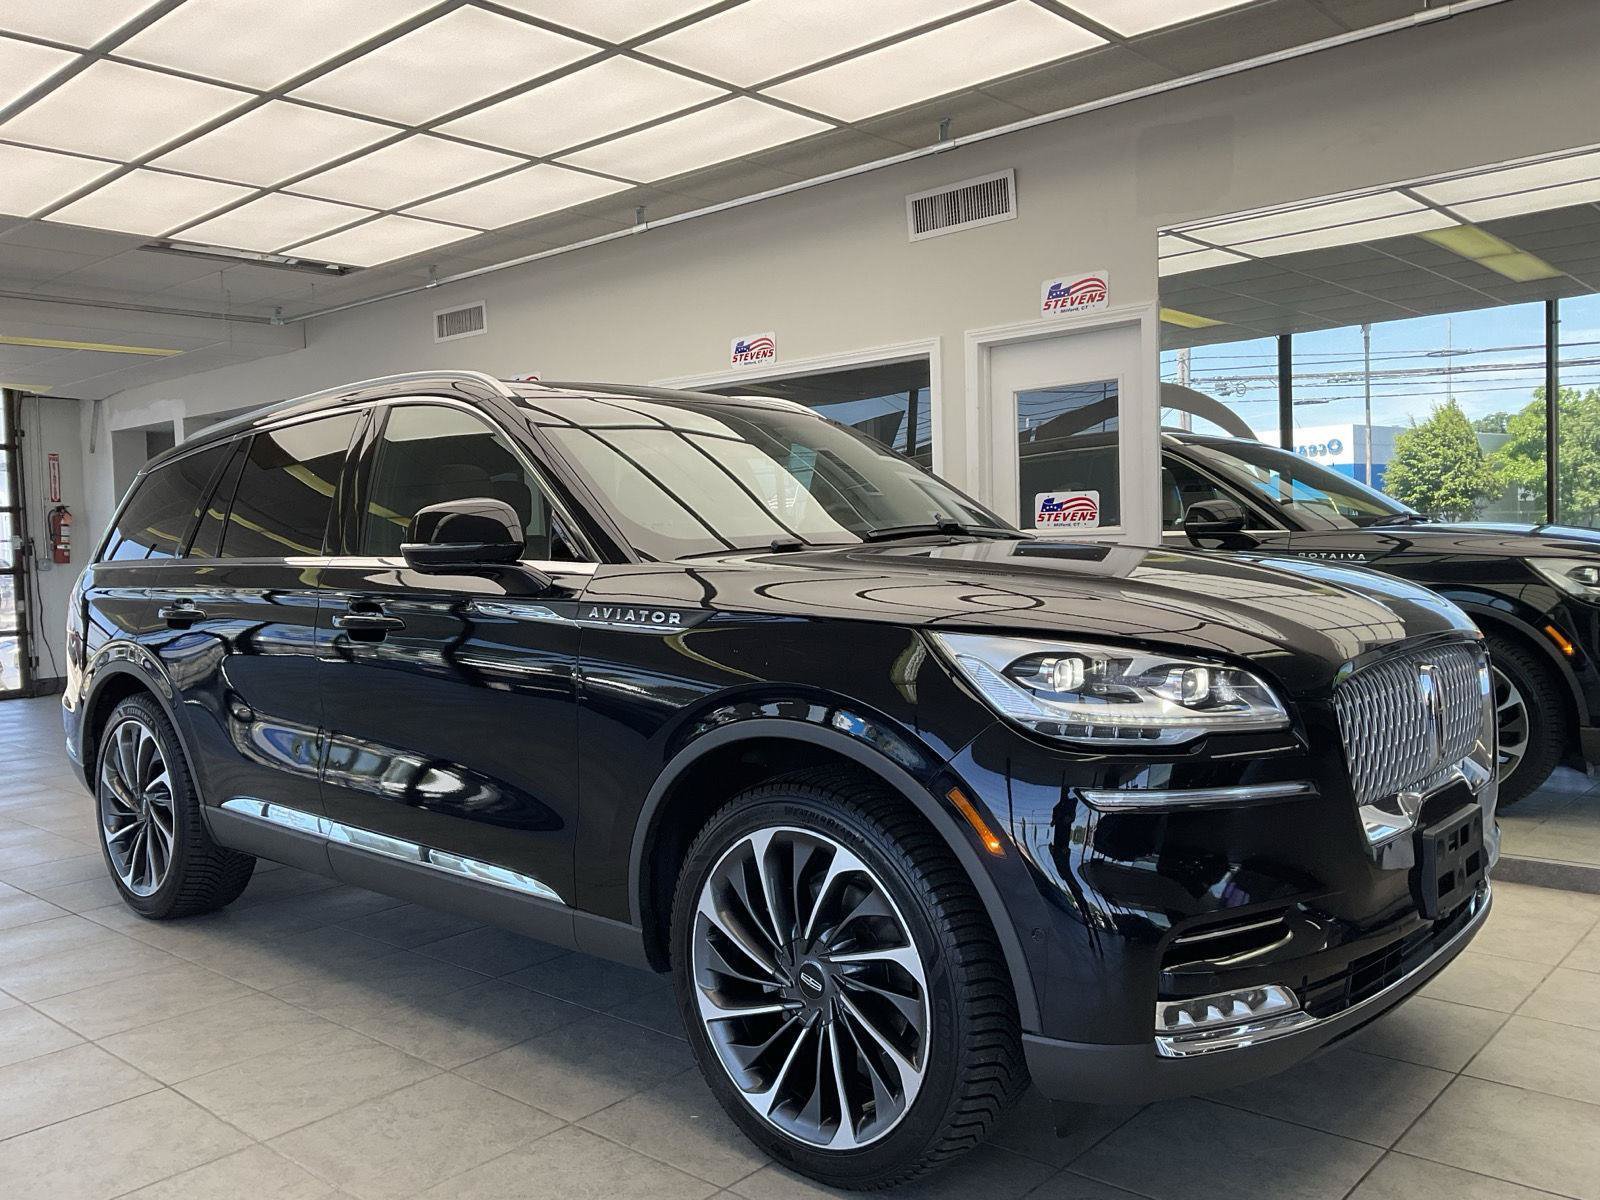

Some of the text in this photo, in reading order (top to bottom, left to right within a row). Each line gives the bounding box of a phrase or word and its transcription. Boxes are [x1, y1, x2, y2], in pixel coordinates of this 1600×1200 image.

[1043, 291, 1107, 310] STEVENS
[732, 349, 774, 363] STEVENS
[1037, 511, 1097, 522] STEVENS
[588, 606, 681, 624] AVIATOR
